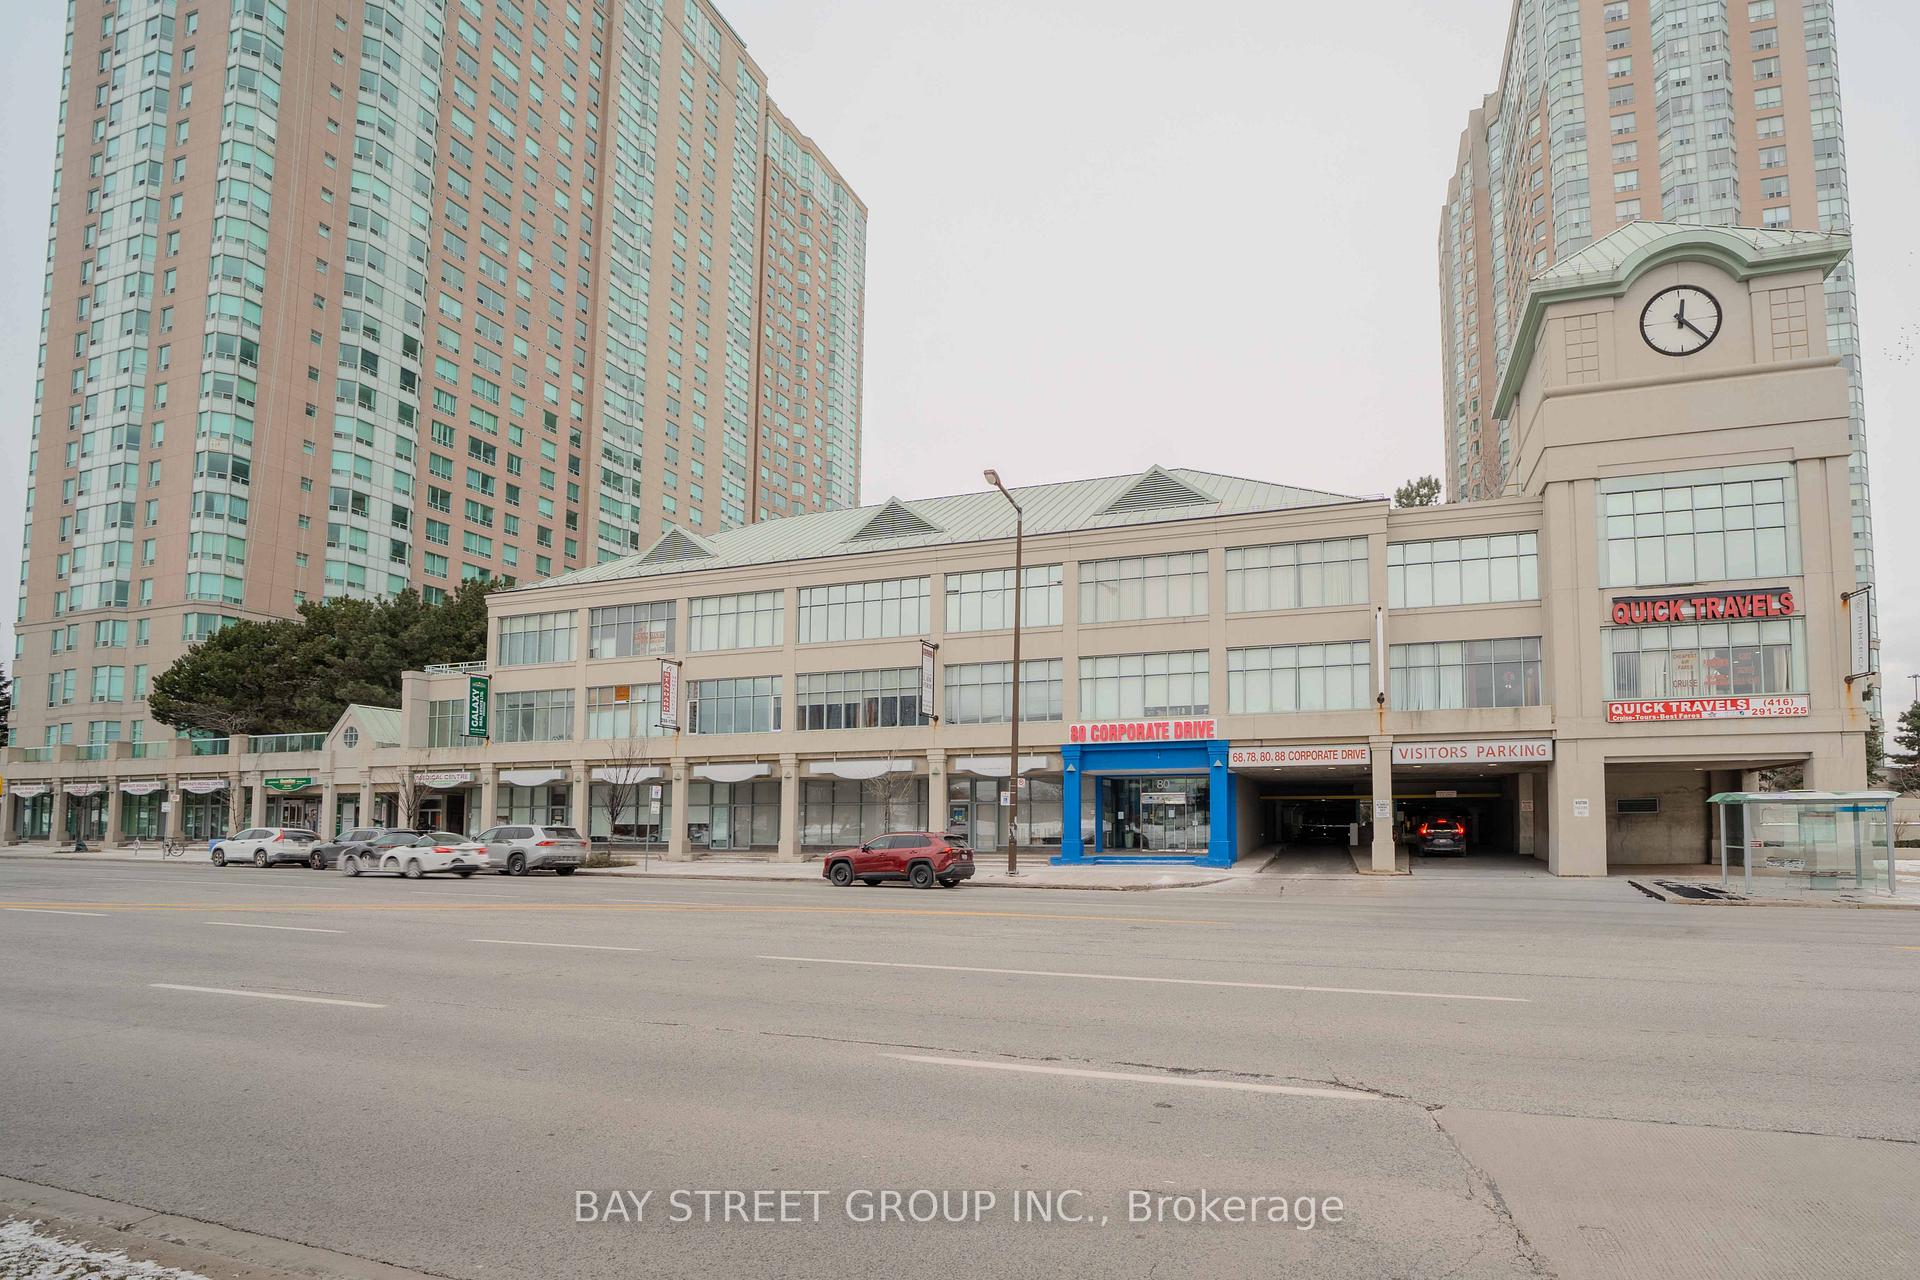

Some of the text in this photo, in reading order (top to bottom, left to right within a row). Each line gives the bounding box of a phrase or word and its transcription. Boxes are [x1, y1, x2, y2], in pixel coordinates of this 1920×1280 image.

[1612, 592, 1796, 625] QUICK TRAVELS
[1672, 679, 1698, 688] CRUISE
[471, 689, 480, 727] GALAXY
[1611, 699, 1747, 715] QUICK TRAVELS
[1763, 698, 1794, 707] (416)
[1752, 707, 1807, 716] 291-2025
[1070, 720, 1215, 742] 80 CORPORATE DRIVE
[1288, 749, 1338, 761] CORPORATE
[1341, 749, 1366, 759] DRIVE
[1399, 744, 1546, 759] VISITORS PARKING
[1156, 779, 1170, 789] 80
